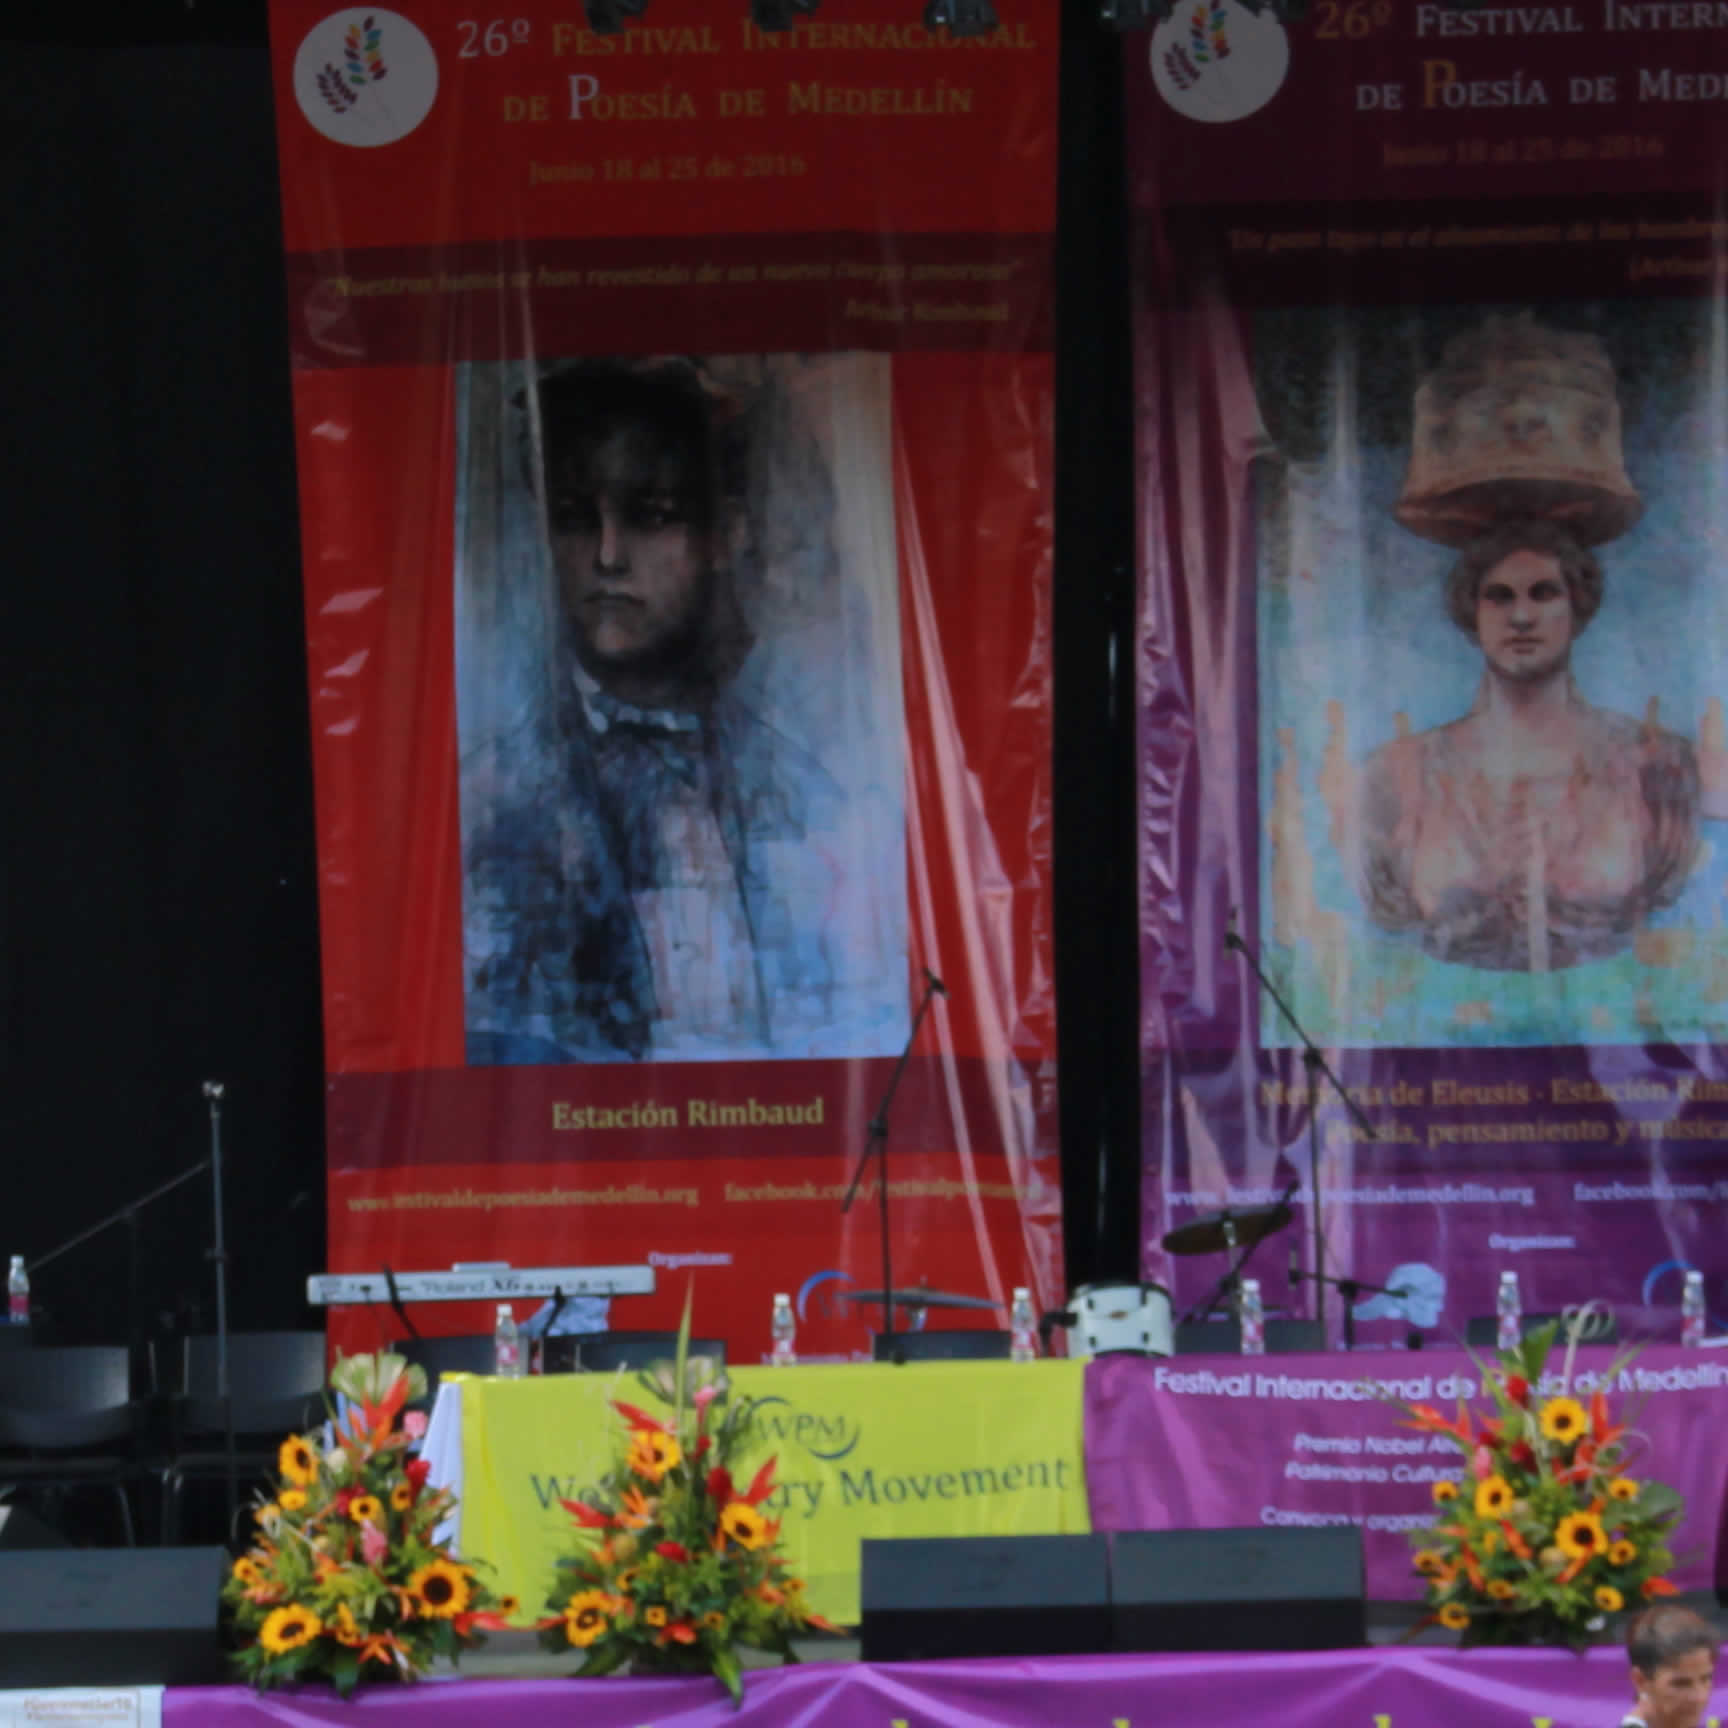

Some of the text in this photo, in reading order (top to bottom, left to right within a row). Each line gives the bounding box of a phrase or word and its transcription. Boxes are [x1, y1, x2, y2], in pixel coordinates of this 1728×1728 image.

[551, 1096, 825, 1131] Estación Rimbaud
[1153, 1366, 1251, 1399] Festival
[837, 1459, 1071, 1508] Movement
